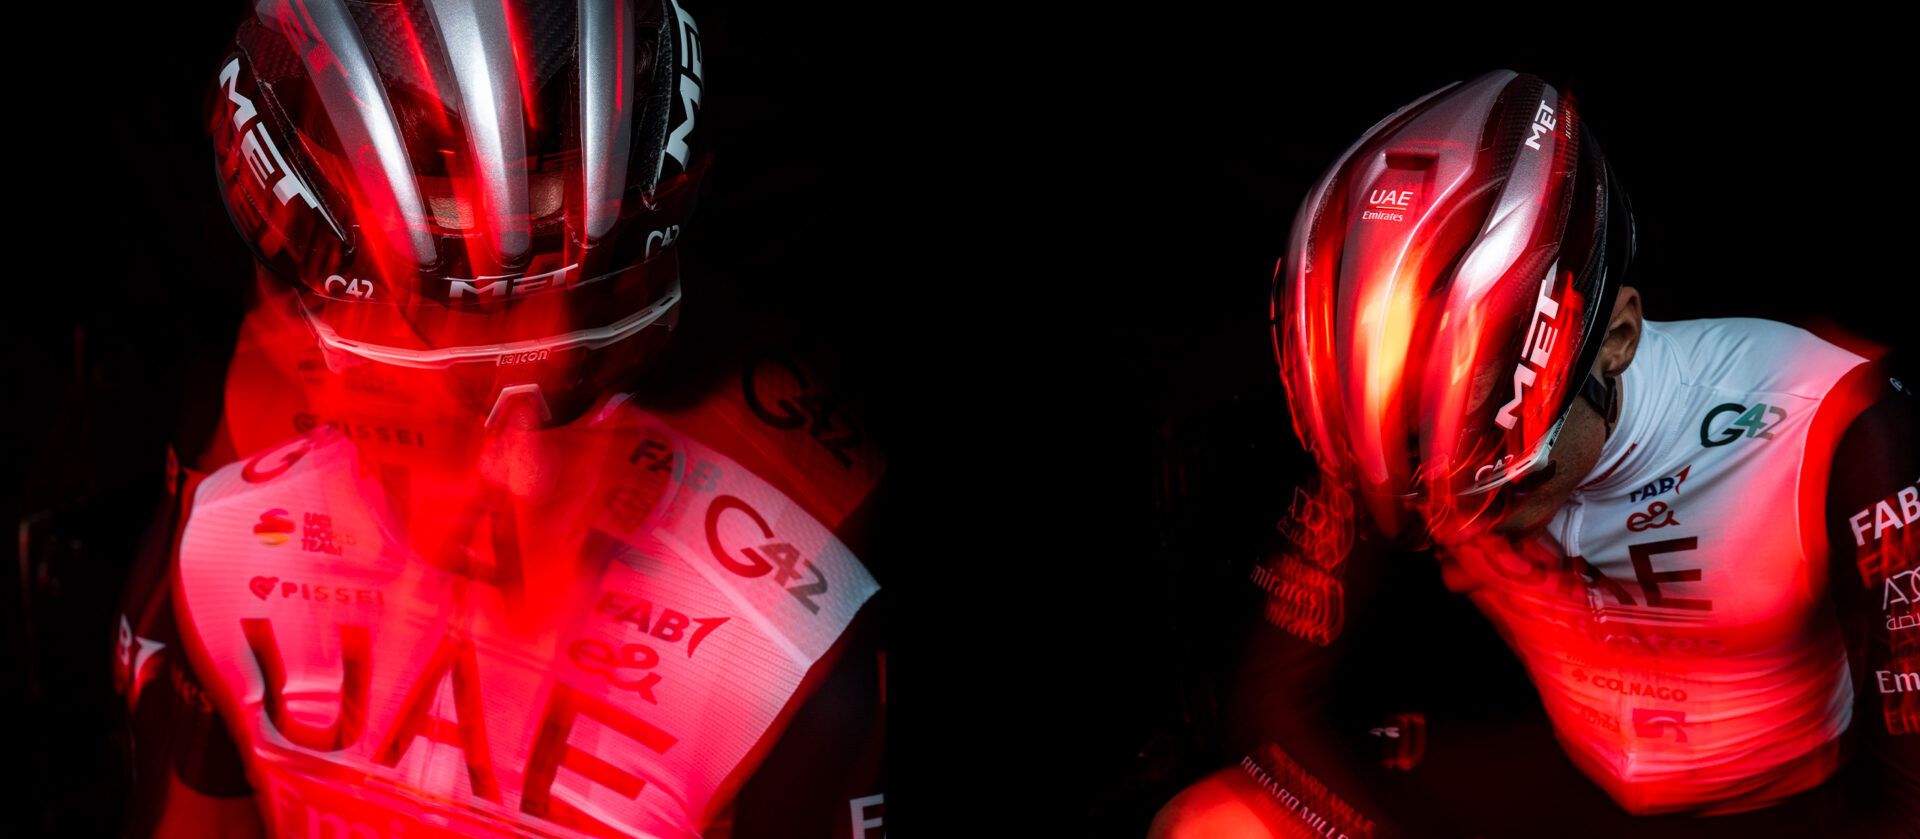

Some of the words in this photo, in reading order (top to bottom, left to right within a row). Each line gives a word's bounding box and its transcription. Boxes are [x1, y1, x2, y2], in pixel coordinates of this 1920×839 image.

[219, 57, 318, 209] MET
[1525, 100, 1557, 150] MET
[1362, 210, 1403, 222] Emirates
[1369, 189, 1413, 206] UAE
[448, 261, 578, 298] MET
[1494, 279, 1559, 430] MET
[1700, 402, 1788, 449] G42
[705, 494, 828, 615] G42
[281, 581, 385, 606] PISSEI
[1592, 675, 1688, 702] COLNAGO
[240, 617, 681, 839] UAE
[1240, 755, 1301, 812] RICHARD
